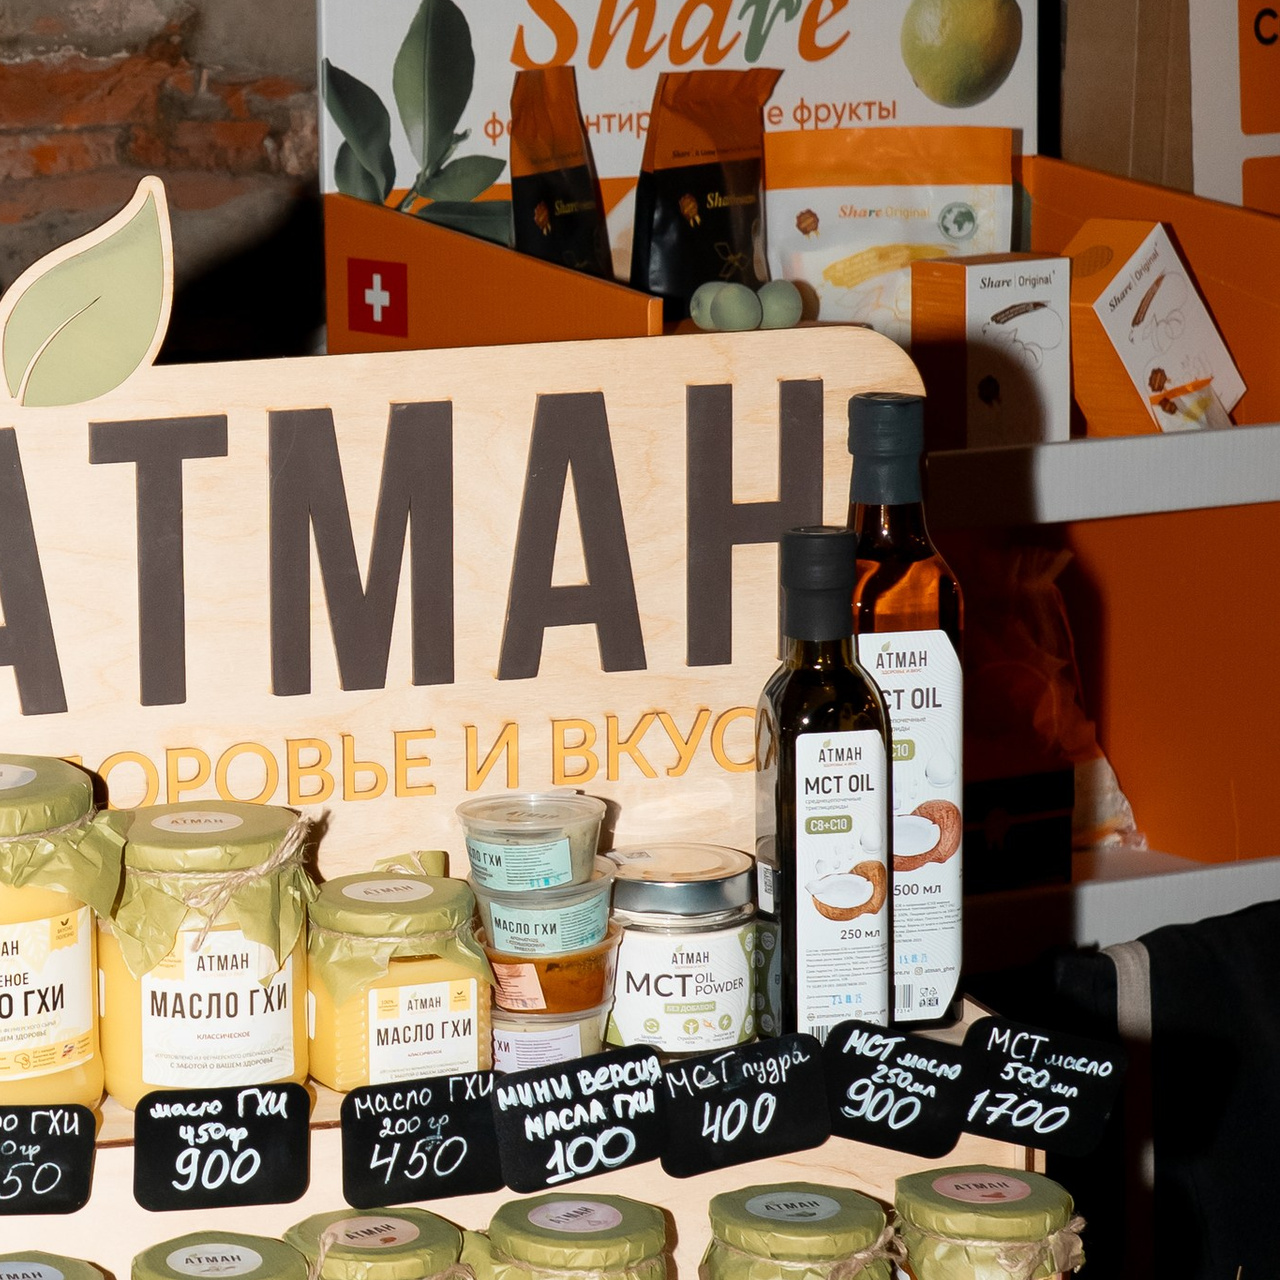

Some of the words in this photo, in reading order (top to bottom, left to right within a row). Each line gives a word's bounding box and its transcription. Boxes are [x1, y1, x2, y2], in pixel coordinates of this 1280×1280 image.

[792, 97, 897, 129] фрукты
[838, 204, 882, 219] Share
[980, 276, 1013, 289] Share
[1018, 273, 1053, 289] Original
[1108, 282, 1134, 313] Share
[876, 650, 928, 669] АТМАН
[911, 687, 942, 709] OIL
[819, 747, 862, 762] АТМАН
[69, 729, 436, 808] ОРОВЬЕ
[465, 721, 520, 792] И
[805, 775, 843, 795] MCT
[849, 773, 874, 792] OIL
[483, 853, 502, 867] ГХИ
[363, 884, 414, 896] АТМАН
[494, 917, 530, 935] МАСЛО
[535, 923, 557, 935] ГХИ
[840, 929, 861, 940] 250
[197, 953, 249, 971] АТМАН
[671, 951, 709, 965] АТМАН
[626, 970, 693, 998] MCT
[694, 973, 716, 984] OIL
[695, 976, 745, 996] POWDER
[24, 983, 64, 1016] ГХИ
[150, 990, 238, 1019] МАСЛО
[250, 983, 287, 1015] ГХИ
[407, 995, 442, 1012] АТМАН
[376, 1023, 434, 1047] МАСЛО
[441, 1018, 473, 1041] ГХИ
[845, 1078, 922, 1130] 900
[966, 1088, 1071, 1134] 1700
[702, 1095, 777, 1143] 400
[370, 1137, 469, 1185] 450
[546, 1126, 636, 1184] 100
[172, 1147, 262, 1193] 900
[954, 1180, 1009, 1192] АТМАН
[764, 1199, 820, 1212] АТМАН
[548, 1206, 592, 1225] АТМАН
[345, 1223, 396, 1242] АТМАН
[185, 1253, 242, 1265] АТМАН
